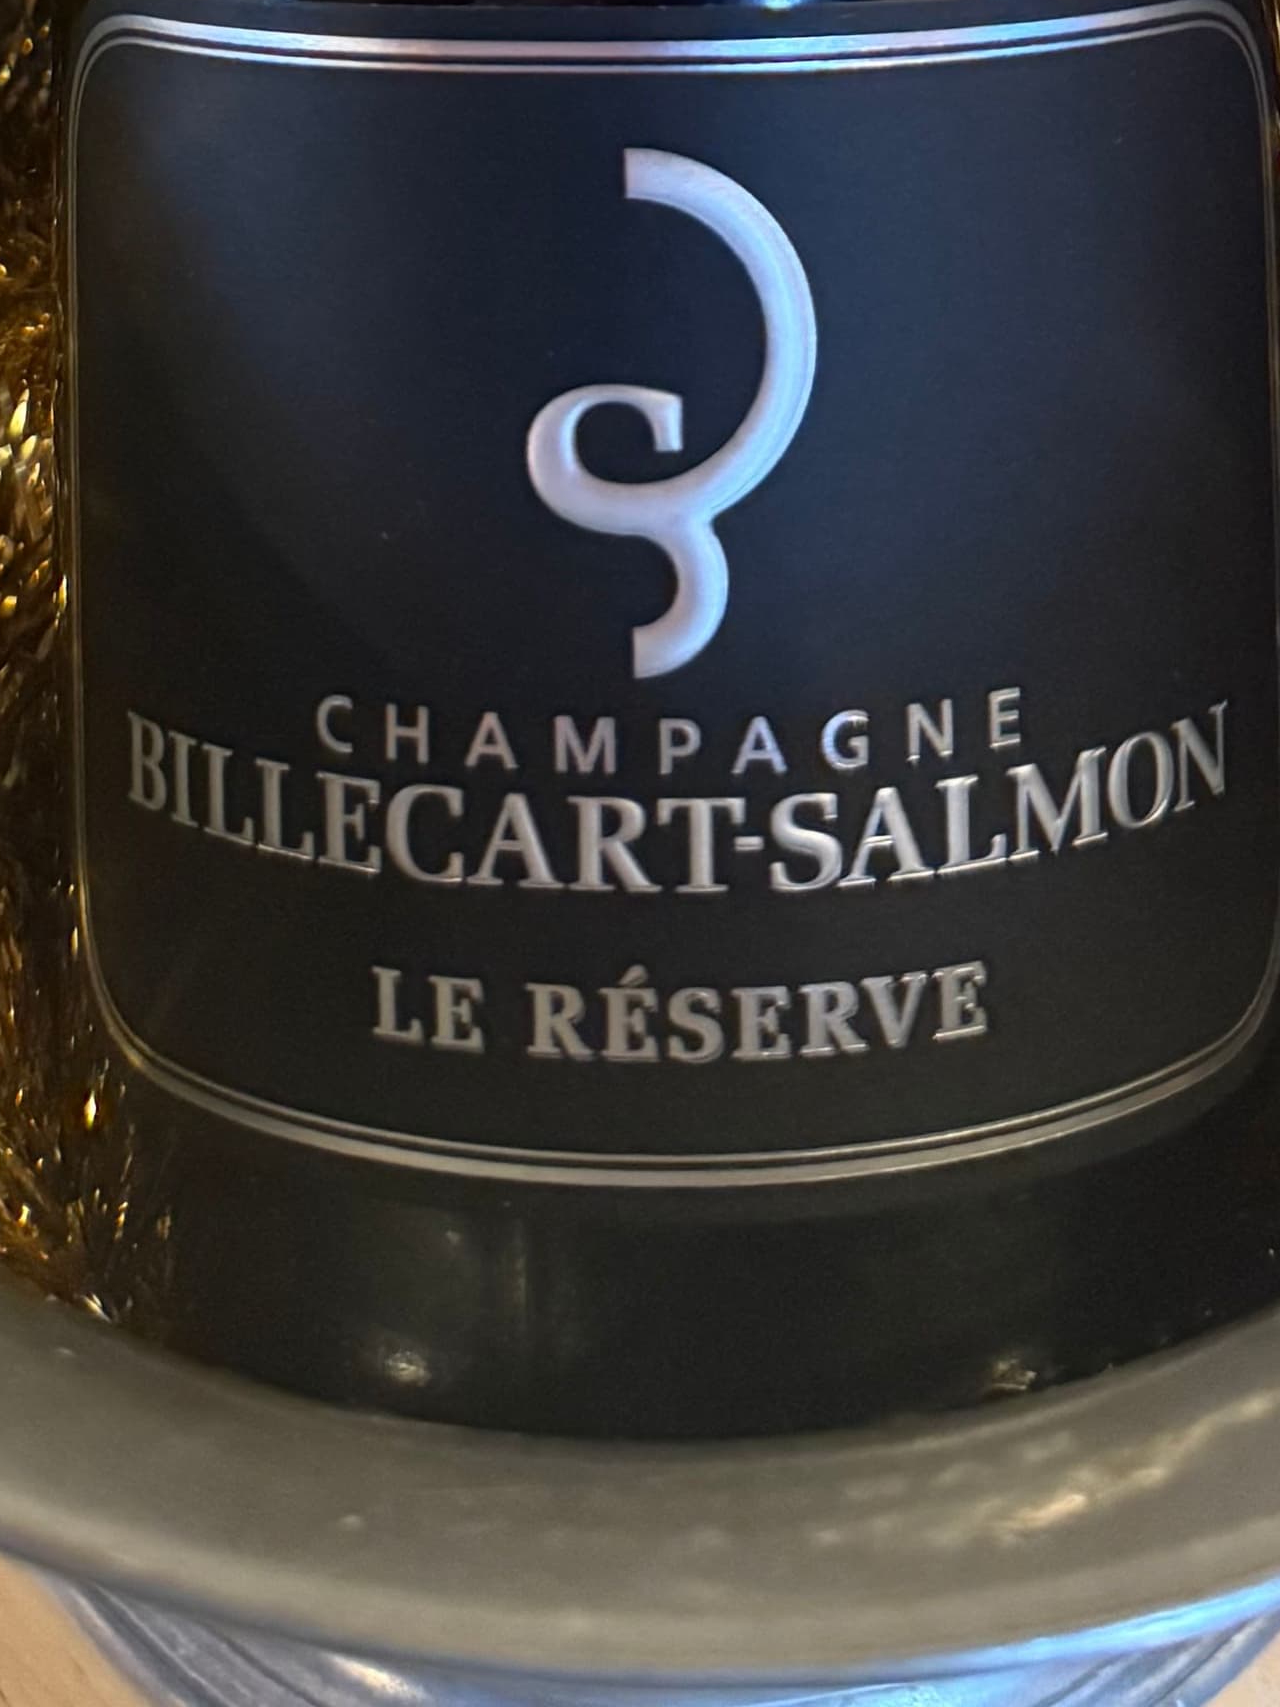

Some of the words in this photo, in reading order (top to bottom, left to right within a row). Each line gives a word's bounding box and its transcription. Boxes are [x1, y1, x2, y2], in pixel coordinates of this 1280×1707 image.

[316, 687, 1023, 776] CHAMPAGNE
[127, 701, 1229, 894] BILLECART-SALMON
[370, 966, 485, 1054] LE
[526, 961, 988, 1062] RÉSERVE
